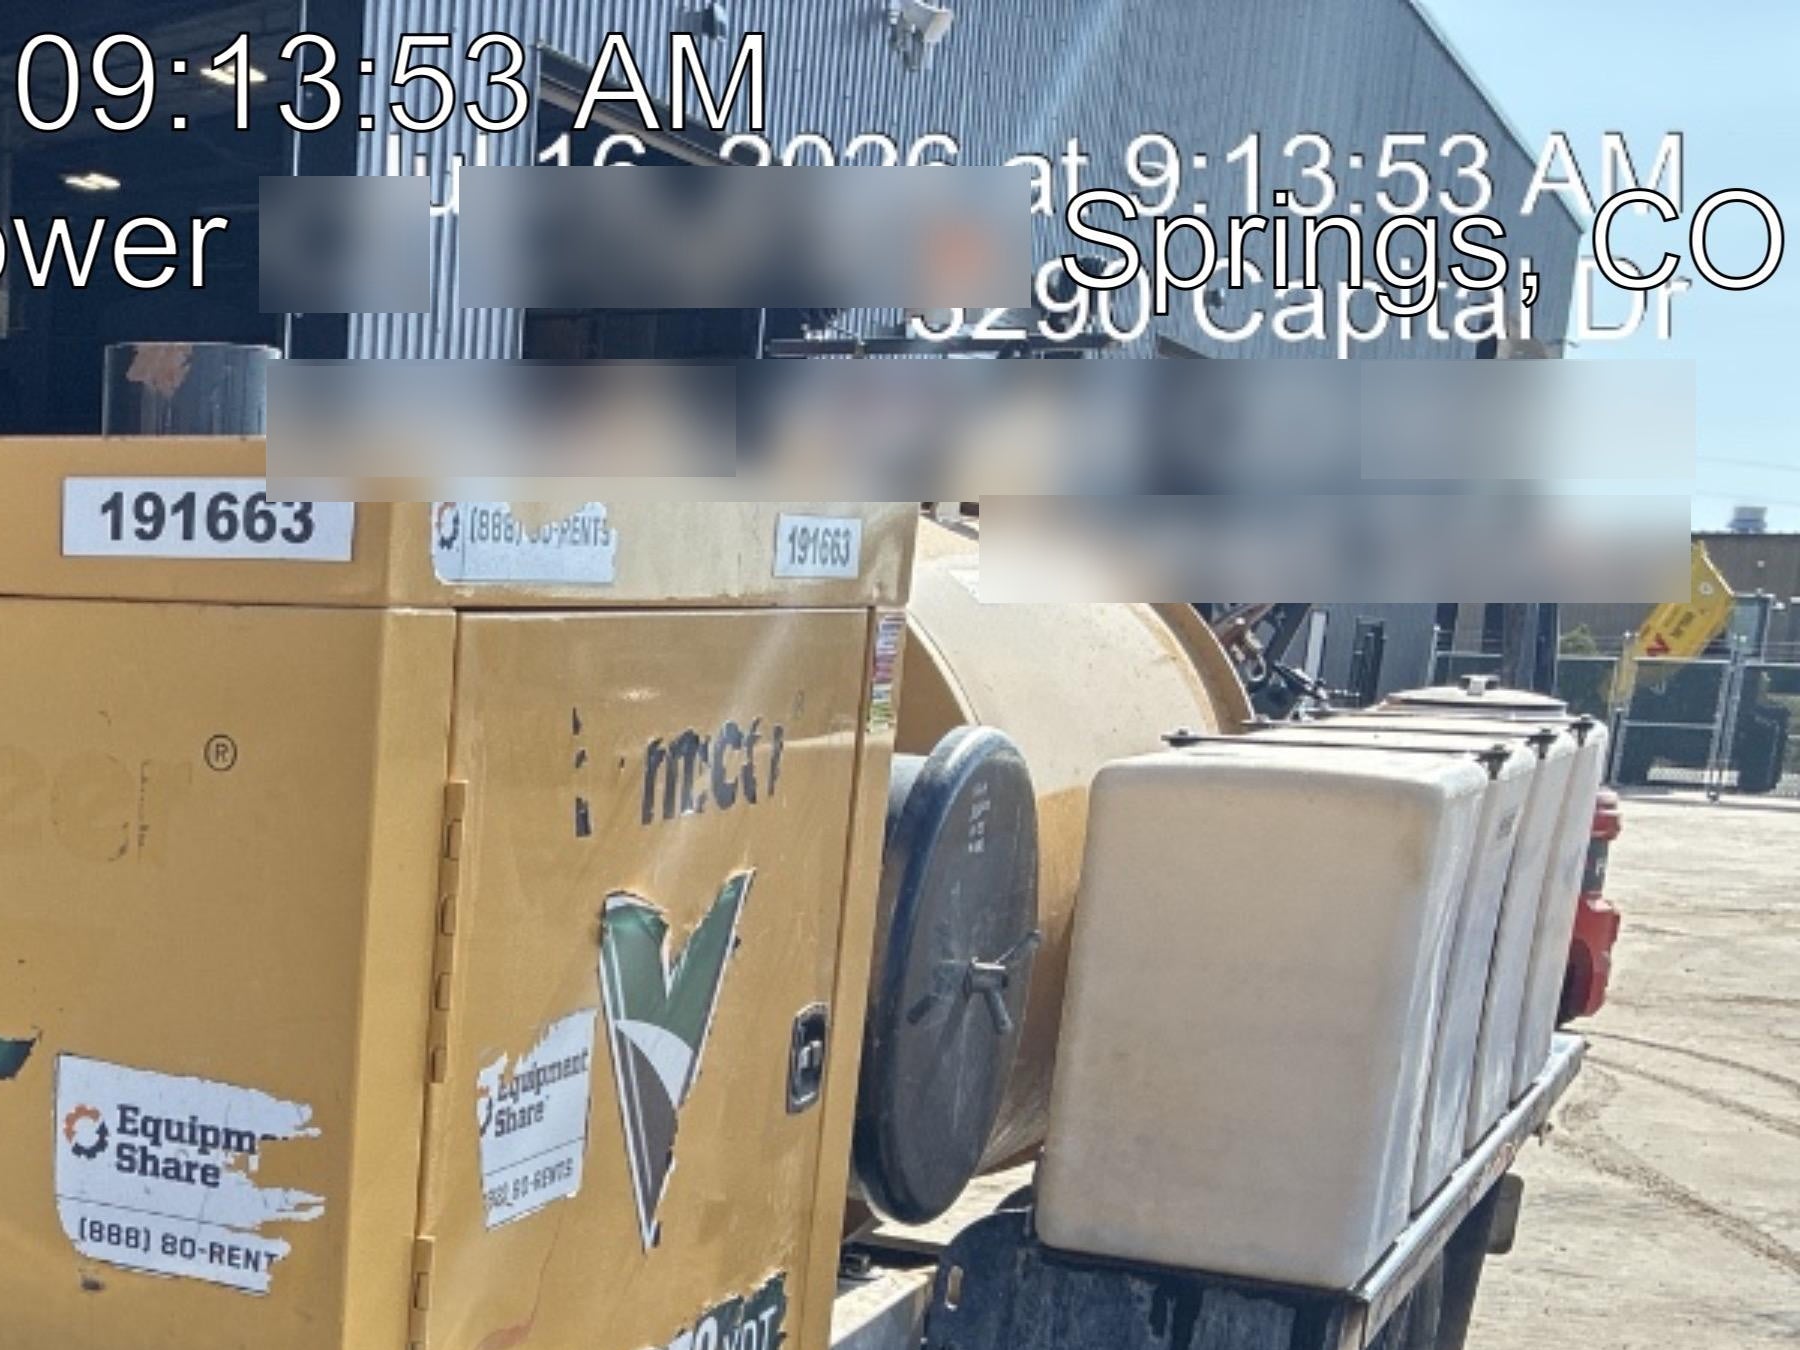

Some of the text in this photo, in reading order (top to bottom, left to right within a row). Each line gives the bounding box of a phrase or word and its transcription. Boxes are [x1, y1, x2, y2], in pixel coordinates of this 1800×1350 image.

[100, 491, 315, 544] 191663
[789, 525, 851, 567] 191663
[494, 1099, 544, 1138] Share
[115, 1143, 220, 1188] Share
[79, 1217, 151, 1253] (888)
